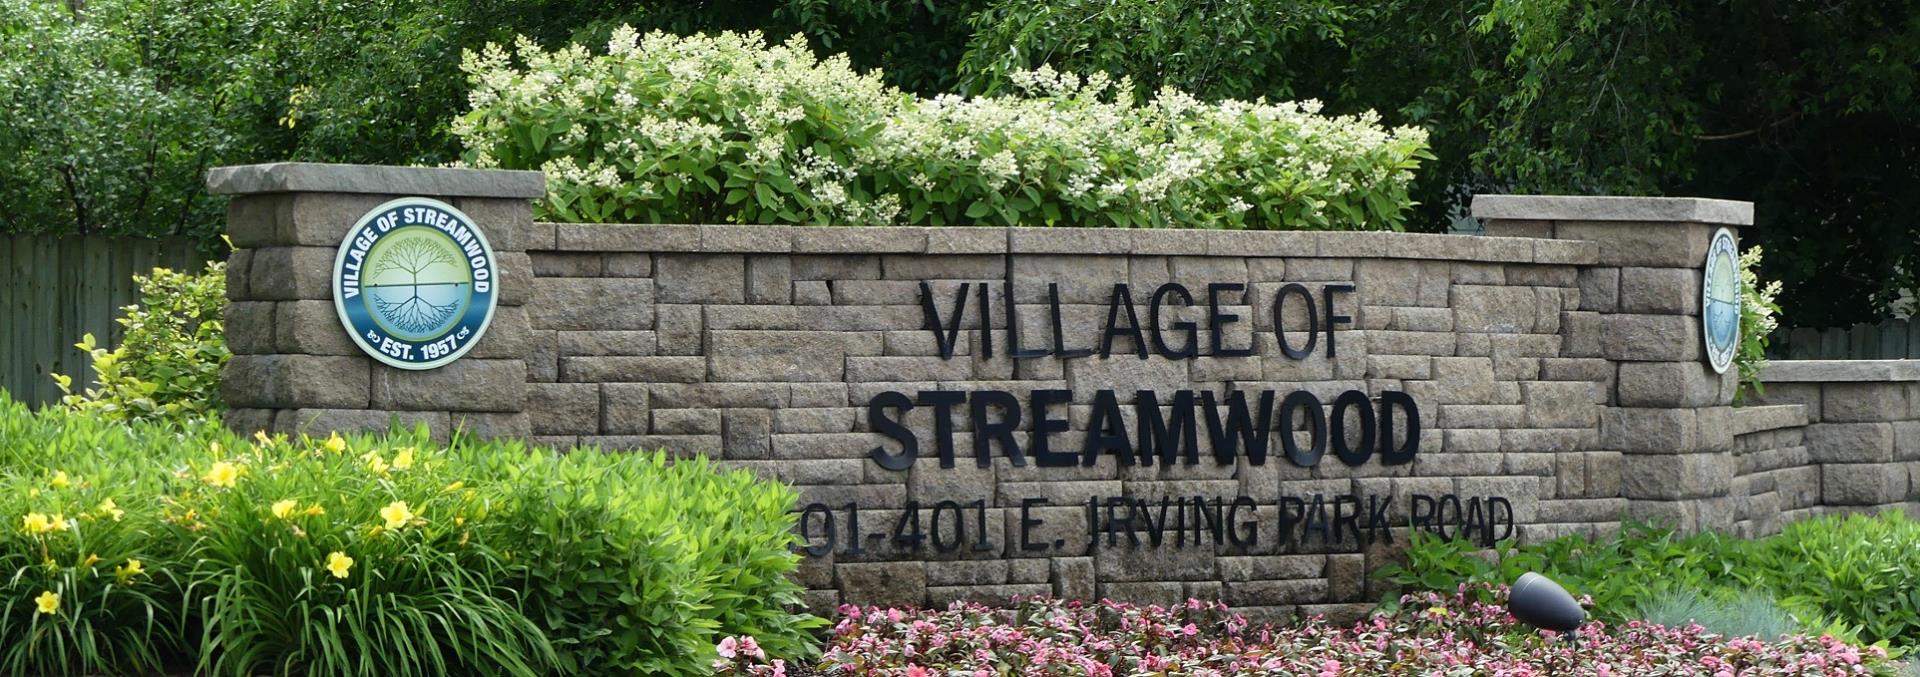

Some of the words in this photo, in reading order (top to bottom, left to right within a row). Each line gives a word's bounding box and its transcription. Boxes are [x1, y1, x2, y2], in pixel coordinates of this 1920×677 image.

[343, 227, 378, 299] VILLAGE
[376, 211, 399, 233] OF
[404, 207, 490, 293] STREAMWOOD
[379, 336, 414, 361] EST.
[420, 335, 458, 360] 1957
[920, 282, 1254, 361] VILLAGE
[1273, 282, 1356, 361] OF
[869, 389, 1421, 472] STREAMWOOD
[787, 499, 994, 556] 01-401
[1021, 498, 1065, 551] E.
[1088, 495, 1258, 549] IRVING
[1279, 494, 1394, 547] PARK
[1411, 494, 1514, 548] ROAD
